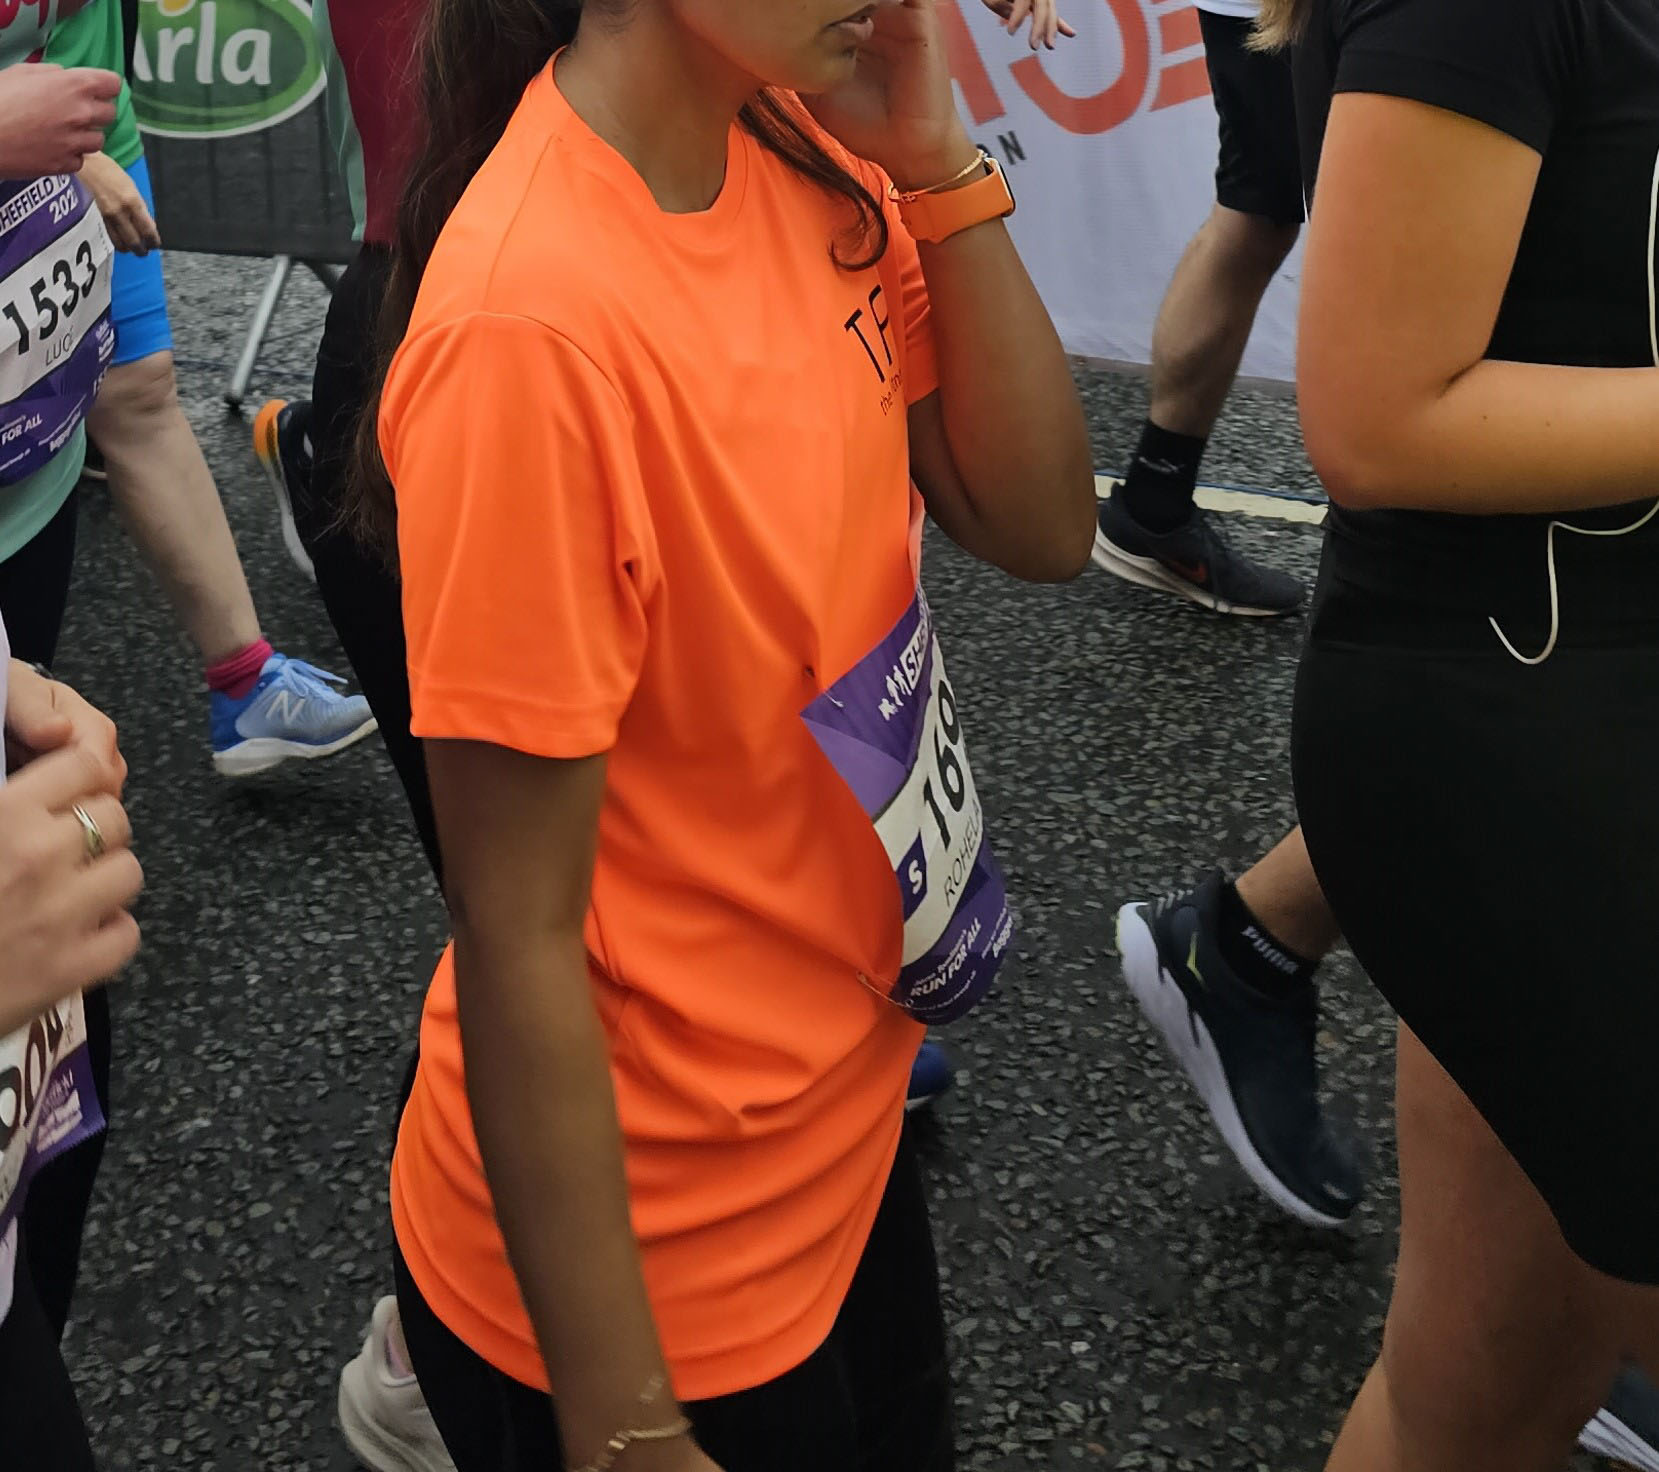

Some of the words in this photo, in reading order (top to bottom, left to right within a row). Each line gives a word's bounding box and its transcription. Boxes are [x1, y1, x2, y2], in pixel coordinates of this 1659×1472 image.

[0, 177, 54, 233] HEFFIELD
[2, 240, 98, 356] 1533
[45, 326, 74, 367] LUC
[24, 414, 43, 433] ALL
[908, 859, 923, 895] S
[948, 943, 967, 979] FOR
[967, 917, 981, 950] ALL
